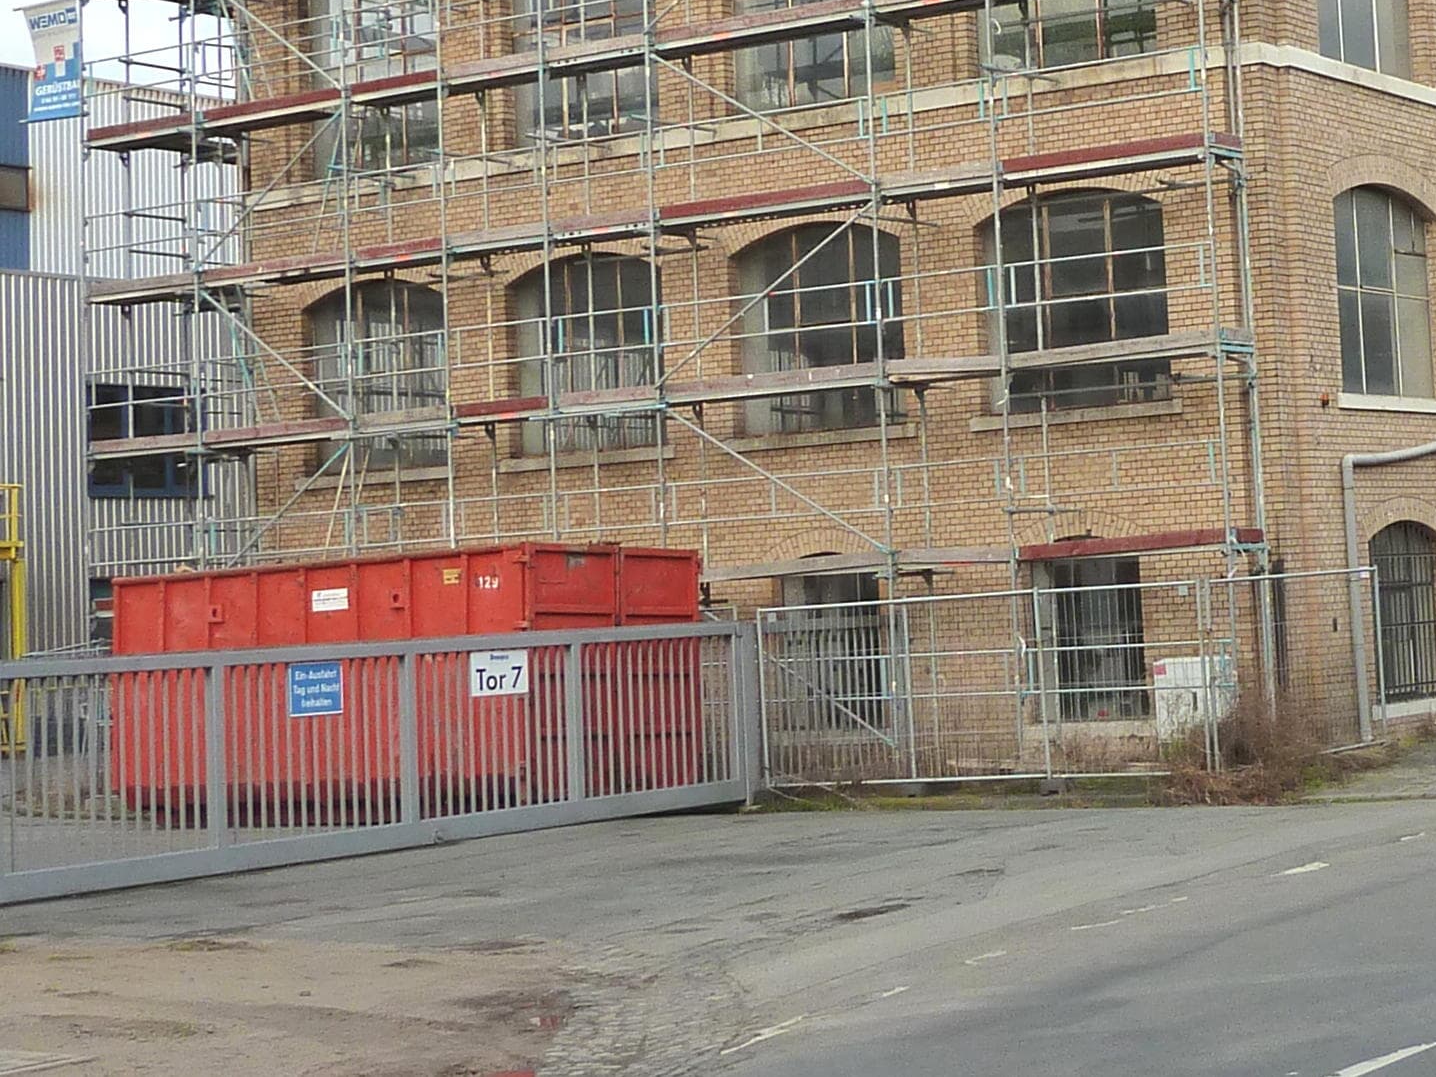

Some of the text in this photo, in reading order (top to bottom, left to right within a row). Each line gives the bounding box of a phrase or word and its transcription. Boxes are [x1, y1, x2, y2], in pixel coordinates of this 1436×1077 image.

[29, 11, 67, 30] WEMO
[478, 576, 499, 589] 129
[475, 665, 523, 691] Tor 7
[306, 683, 320, 694] und
